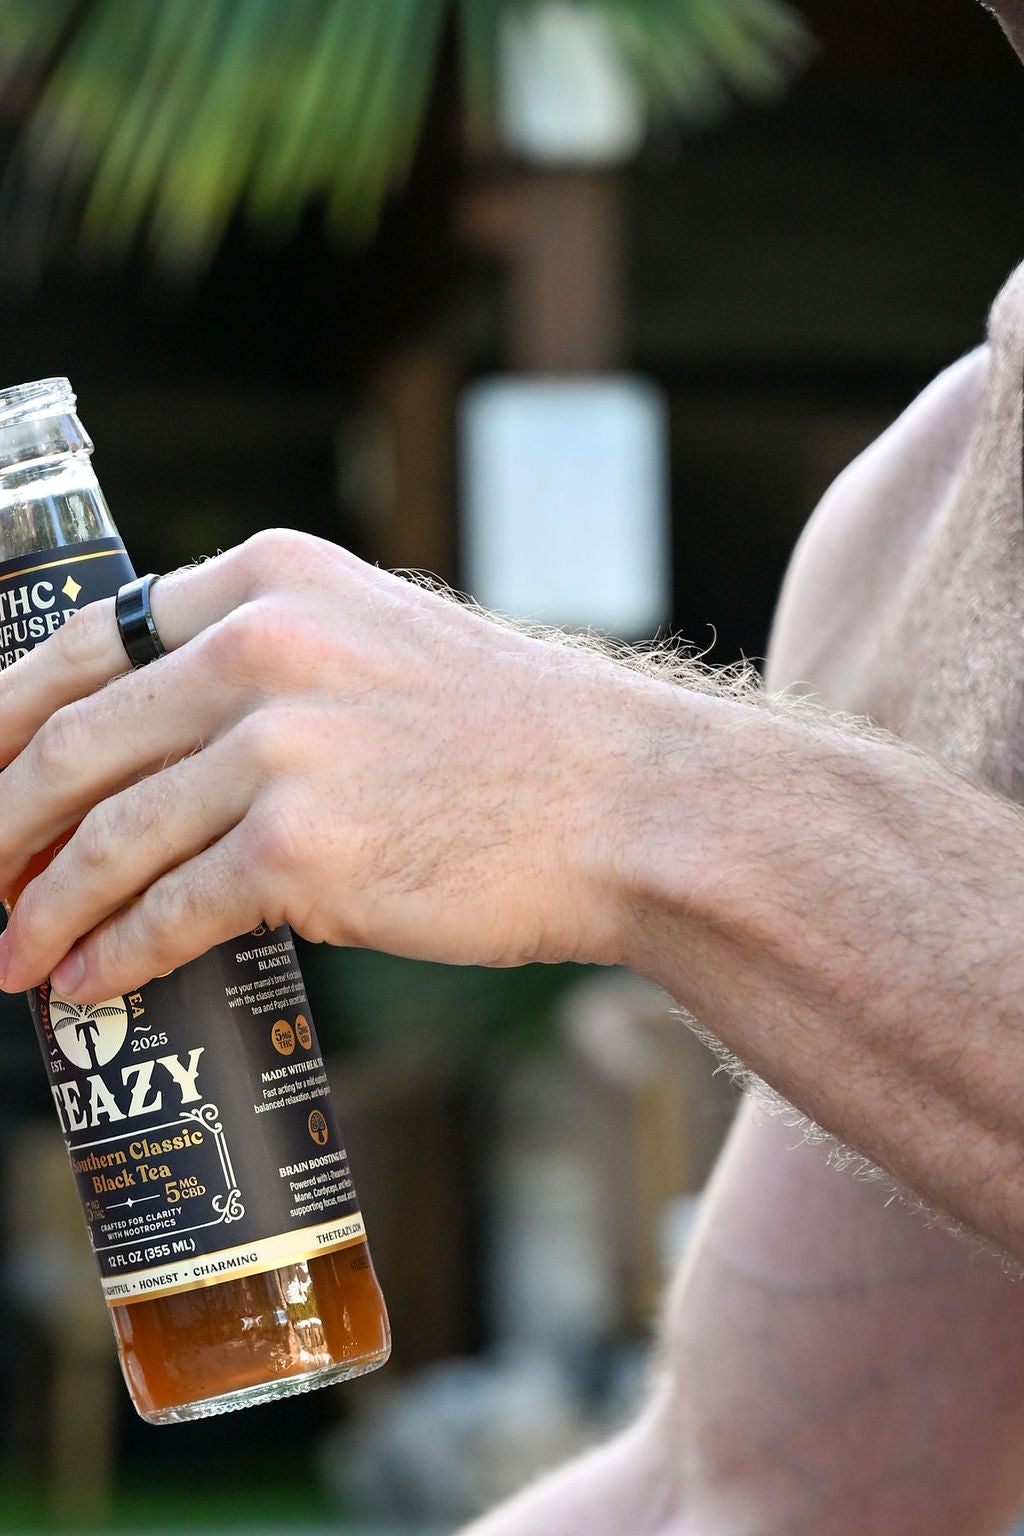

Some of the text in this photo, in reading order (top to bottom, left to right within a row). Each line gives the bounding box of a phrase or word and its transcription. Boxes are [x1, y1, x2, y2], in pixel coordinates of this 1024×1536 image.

[236, 945, 277, 962] SOUTHERN
[258, 958, 281, 970] BLACK
[225, 982, 252, 996] Not your
[228, 995, 255, 1008] with the
[252, 1006, 262, 1015] tea
[50, 1032, 168, 1073] EST. 2025
[261, 1068, 288, 1082] MADE
[287, 1062, 306, 1075] WITH
[263, 1083, 296, 1098] Fast acting
[254, 1099, 284, 1113] balanced
[129, 1128, 204, 1159] Classic
[279, 1161, 308, 1178] BRAIN
[92, 1163, 172, 1194] Black Tea
[290, 1176, 316, 1191] Powered
[294, 1190, 313, 1203] Mane,
[289, 1200, 323, 1217] supporting
[101, 1207, 182, 1232] CRAFTED FOR CLARITY
[107, 1219, 176, 1240] WITH NOOTROPICS
[108, 1238, 195, 1268] 12 FL OZ (355 ML)
[140, 1253, 258, 1289] HONEST CHARMING
